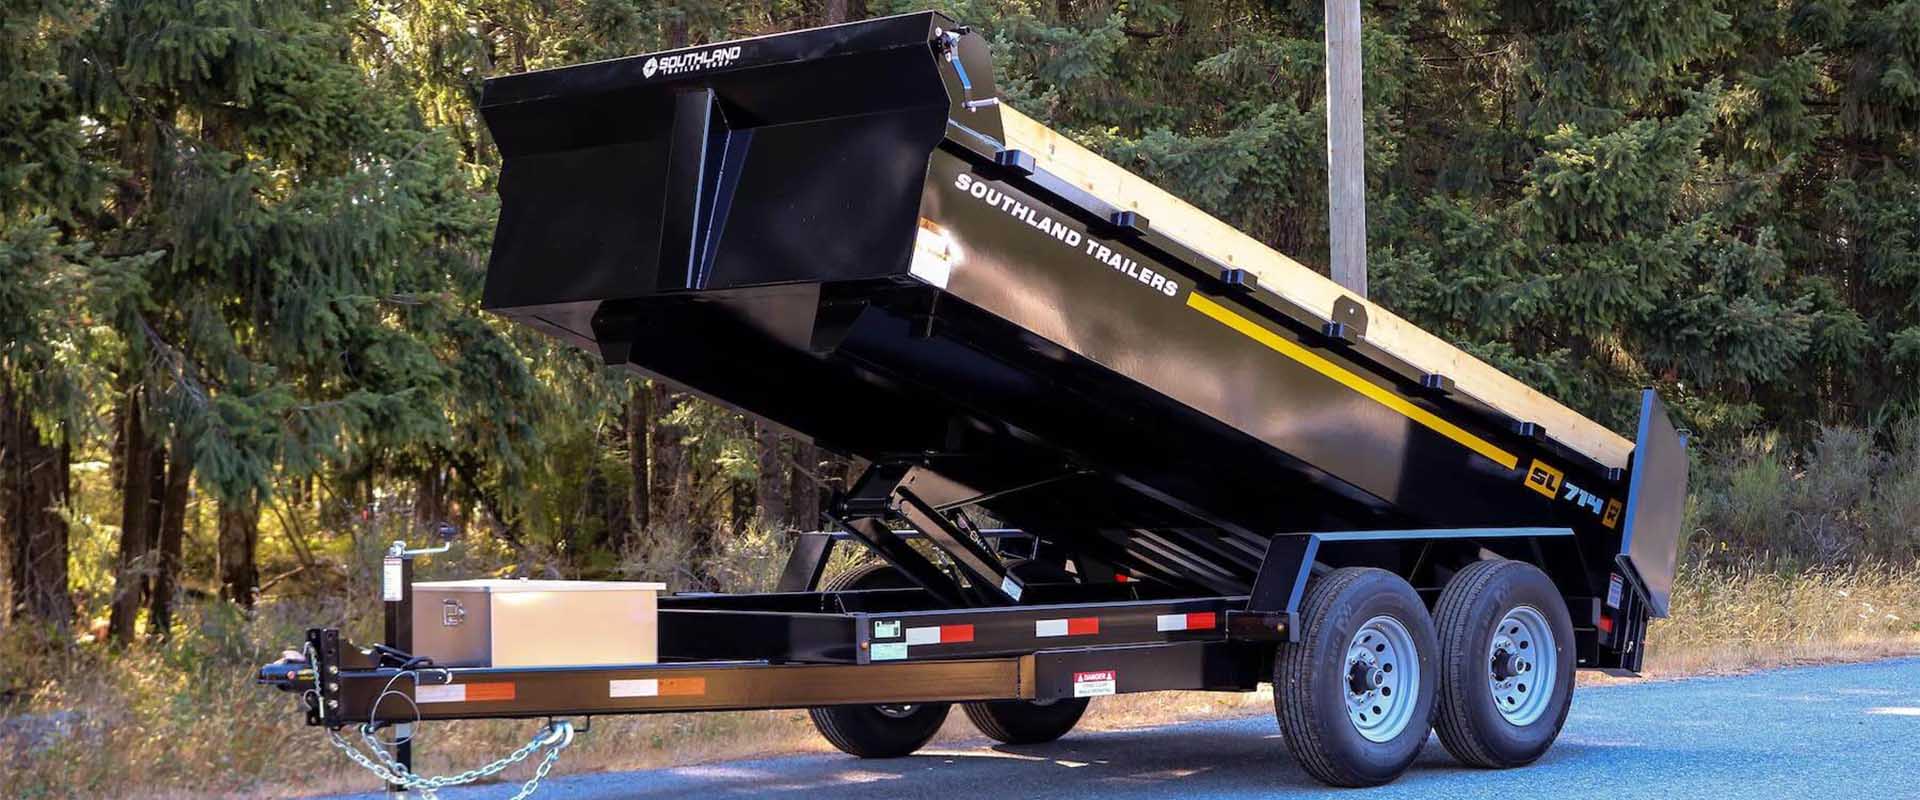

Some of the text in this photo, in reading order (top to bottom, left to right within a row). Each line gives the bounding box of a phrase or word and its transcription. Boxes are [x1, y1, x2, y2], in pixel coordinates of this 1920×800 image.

[659, 46, 741, 70] SOUTHLAND
[955, 173, 1178, 296] SOUTHLAND TRAILERS
[1531, 467, 1556, 492] SL
[1564, 481, 1604, 515] 714
